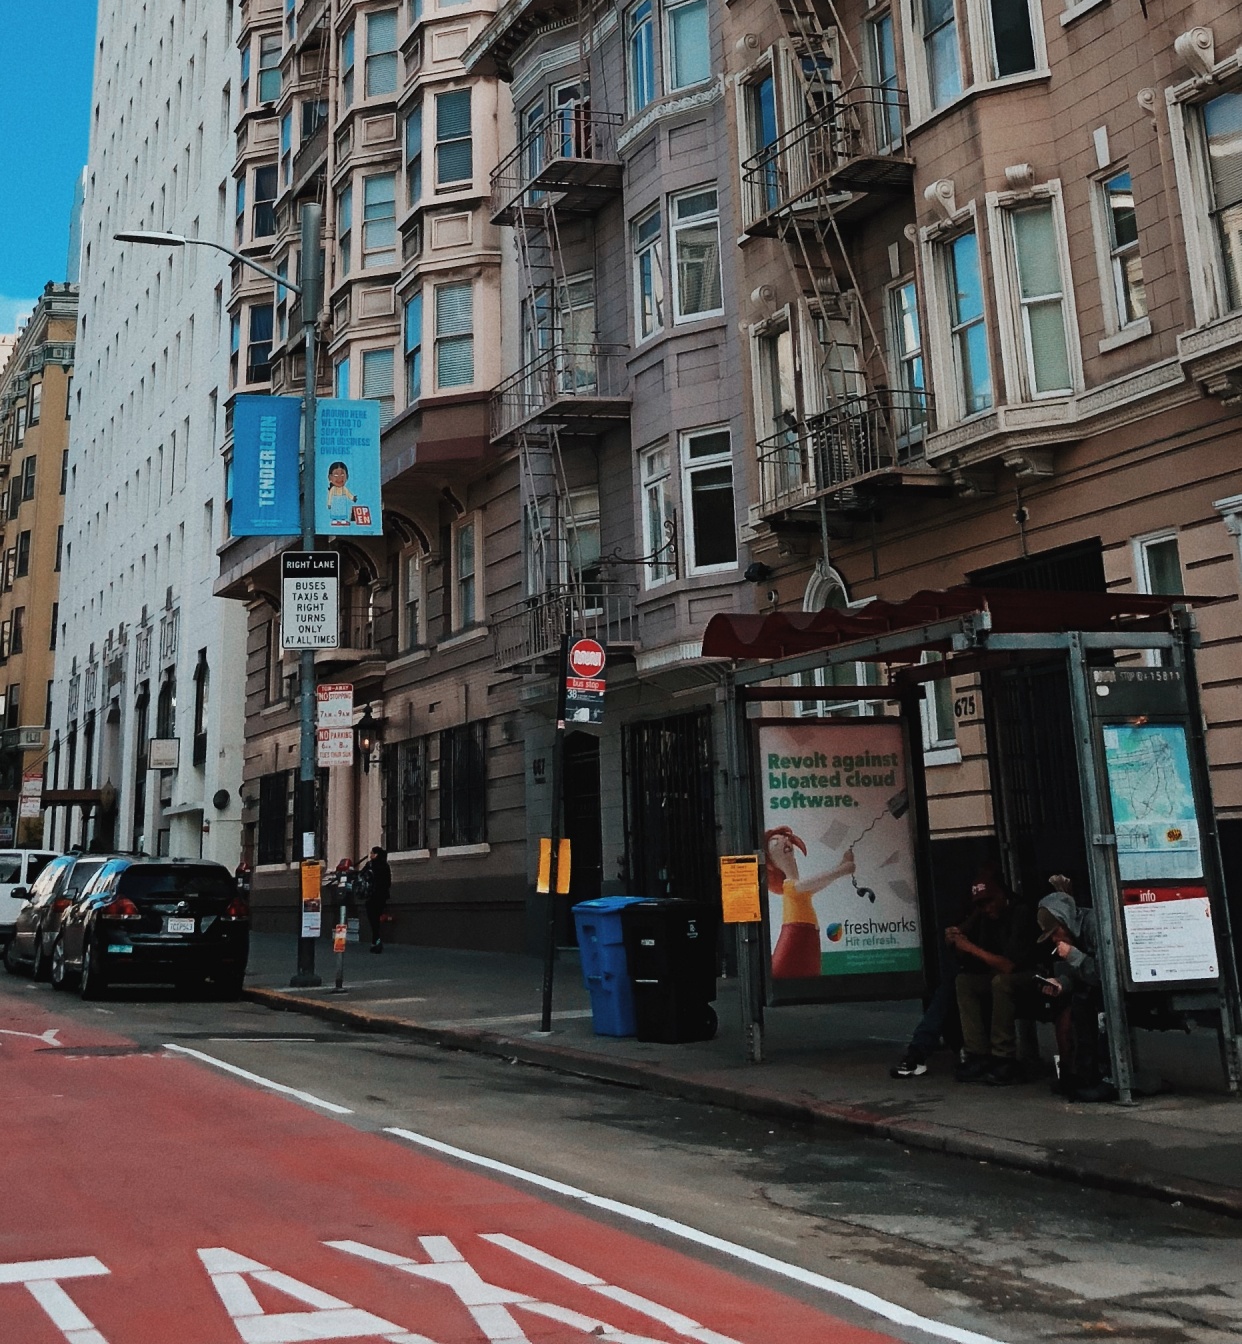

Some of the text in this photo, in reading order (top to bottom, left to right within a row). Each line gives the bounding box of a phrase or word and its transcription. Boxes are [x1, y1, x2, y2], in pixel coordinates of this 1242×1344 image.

[321, 409, 368, 419] AROUND HERE
[321, 418, 362, 428] WE TEND TO
[320, 427, 353, 436] SUPPORT
[320, 437, 371, 447] OUR BUSINESS
[259, 416, 277, 507] TENDERLOIN
[286, 561, 335, 569] RIGHT LANE
[295, 581, 326, 591] BUSES
[292, 592, 329, 602] TAXIS &
[296, 603, 325, 612] RIGHT
[295, 613, 326, 623] TURNS
[298, 624, 323, 634] ONLY
[285, 635, 336, 645] AT ALL TIMES
[572, 679, 600, 690] bus stop
[318, 692, 352, 701] NO STOPPING
[566, 689, 578, 699] 38
[954, 695, 975, 718] 675
[319, 729, 352, 740] NO PARKING
[768, 750, 898, 772] Revolt against
[769, 770, 895, 789] bloated cloud
[770, 791, 859, 809] software.
[1140, 889, 1157, 902] info
[844, 917, 917, 934] freshworks
[845, 935, 900, 946] Hit refresh.
